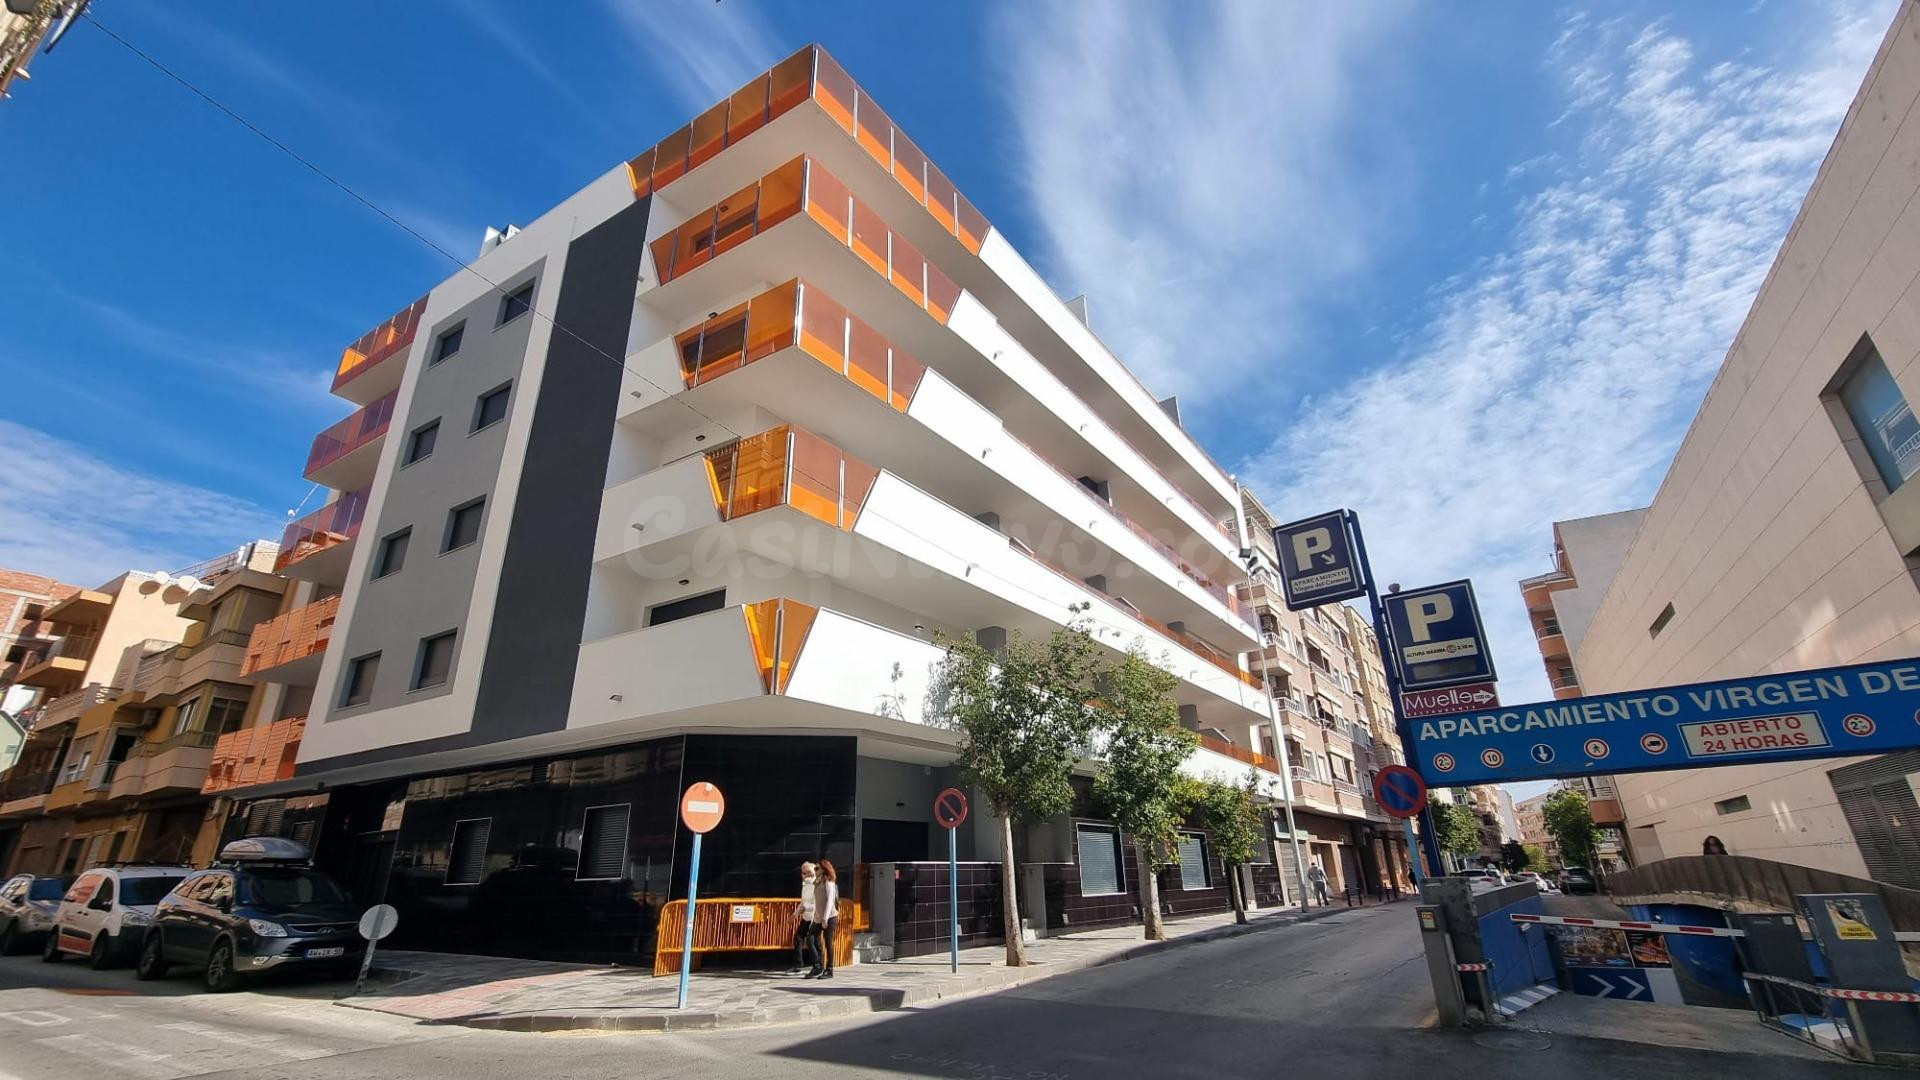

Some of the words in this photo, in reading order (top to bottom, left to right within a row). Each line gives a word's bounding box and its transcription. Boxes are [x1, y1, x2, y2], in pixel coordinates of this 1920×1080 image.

[1291, 527, 1332, 572] P
[1294, 570, 1347, 586] APARCAMIENTO
[1404, 593, 1454, 642] P
[1405, 689, 1472, 710] Muelle
[1420, 695, 1680, 741] APARCAMIENTO
[1689, 675, 1849, 712] VIRGEN
[1858, 667, 1920, 695] DE
[1700, 716, 1801, 737] ABIERTO
[1703, 740, 1727, 753] 24
[1732, 732, 1809, 750] HORAS
[1487, 754, 1498, 762] 10
